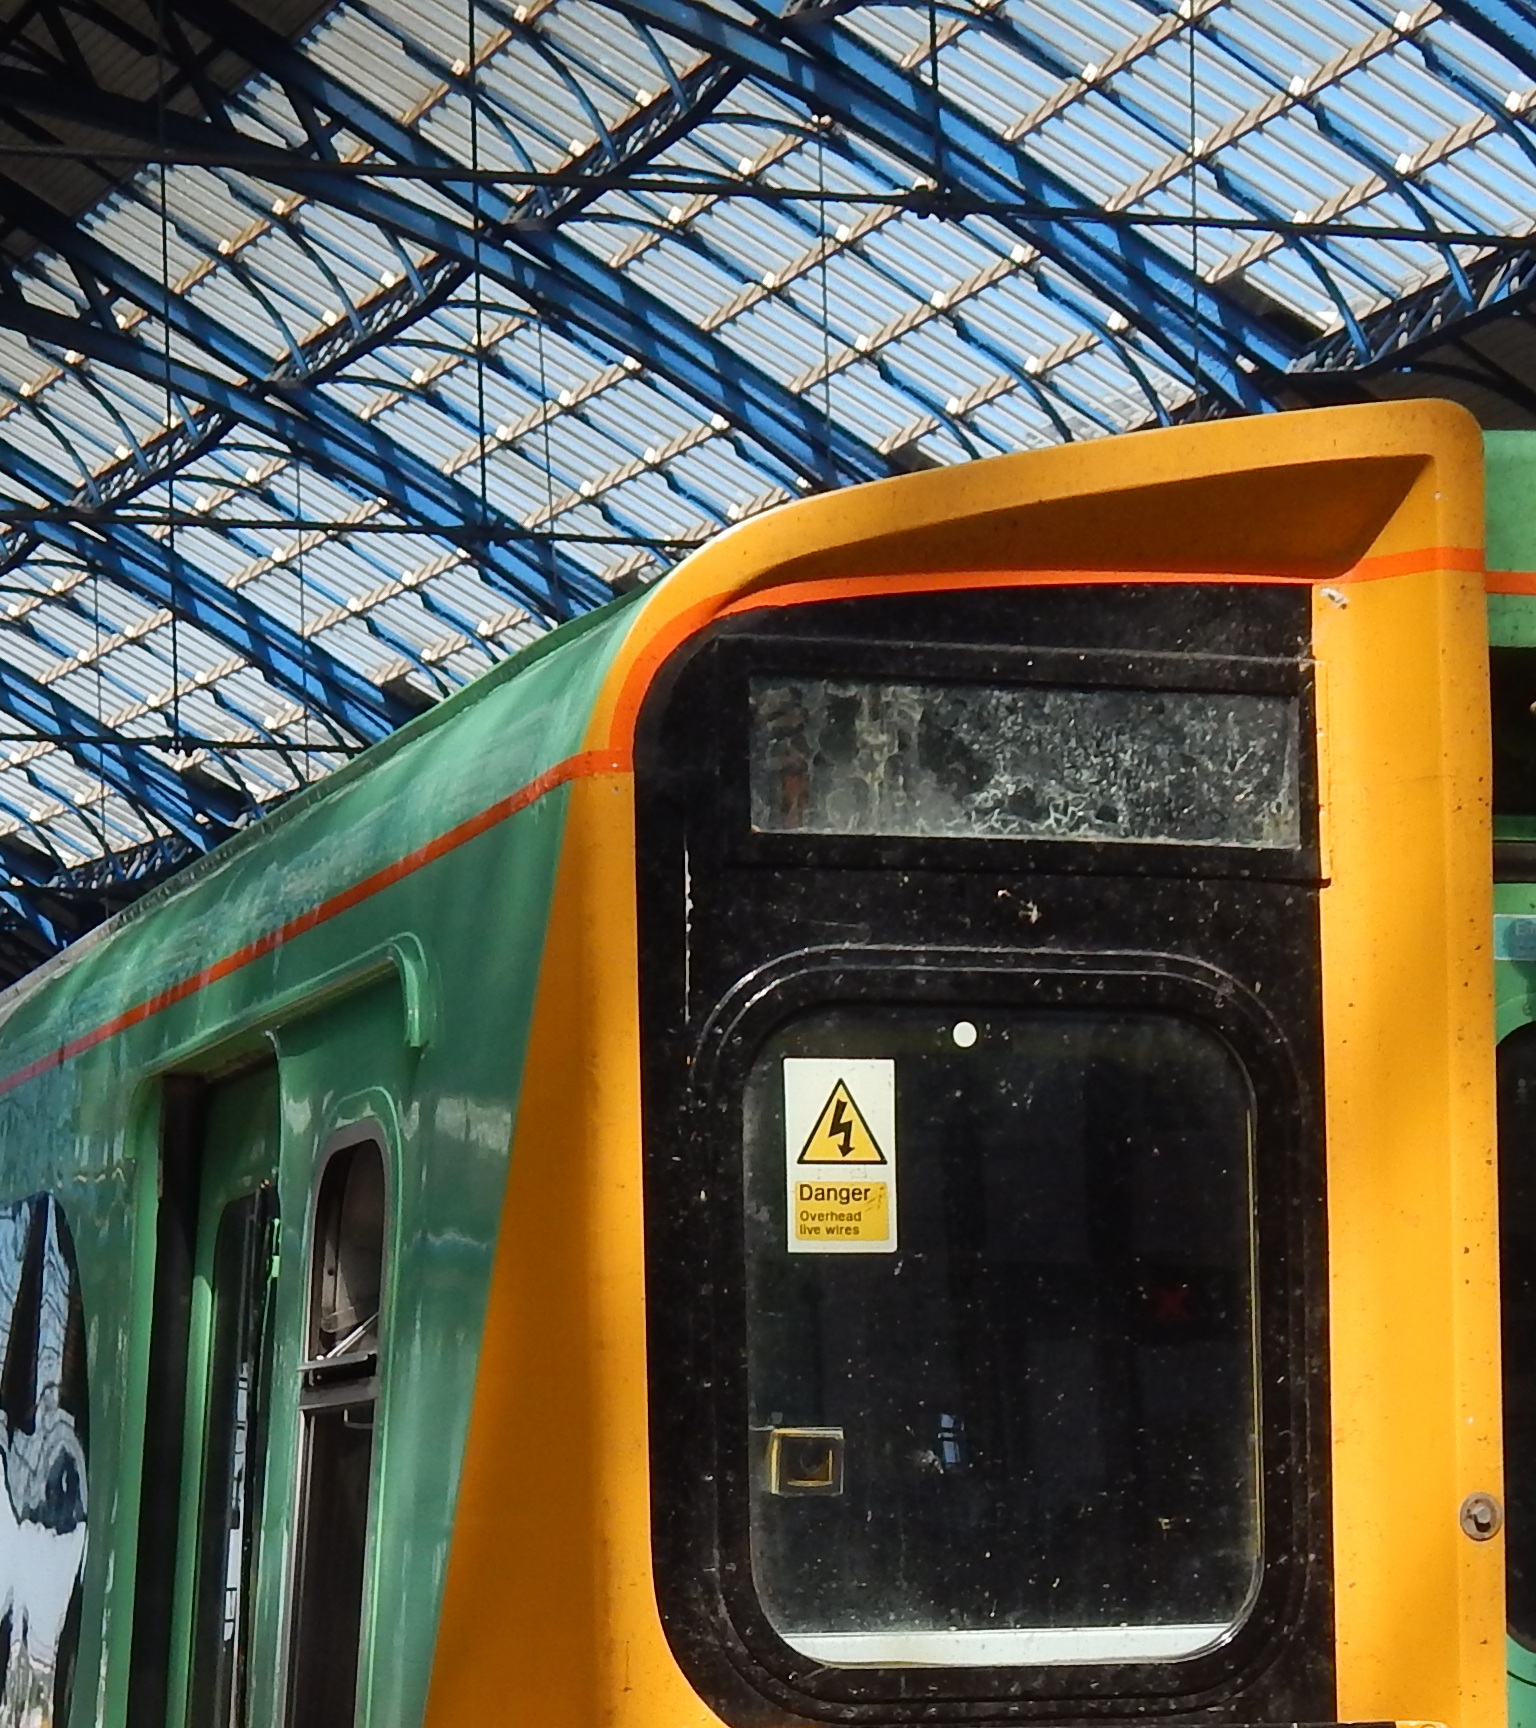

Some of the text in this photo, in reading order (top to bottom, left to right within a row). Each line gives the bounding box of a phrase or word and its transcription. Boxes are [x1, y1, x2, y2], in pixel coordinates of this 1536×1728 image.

[799, 1183, 871, 1205] Danger
[799, 1210, 862, 1222] Overhead
[799, 1223, 860, 1236] live wires
